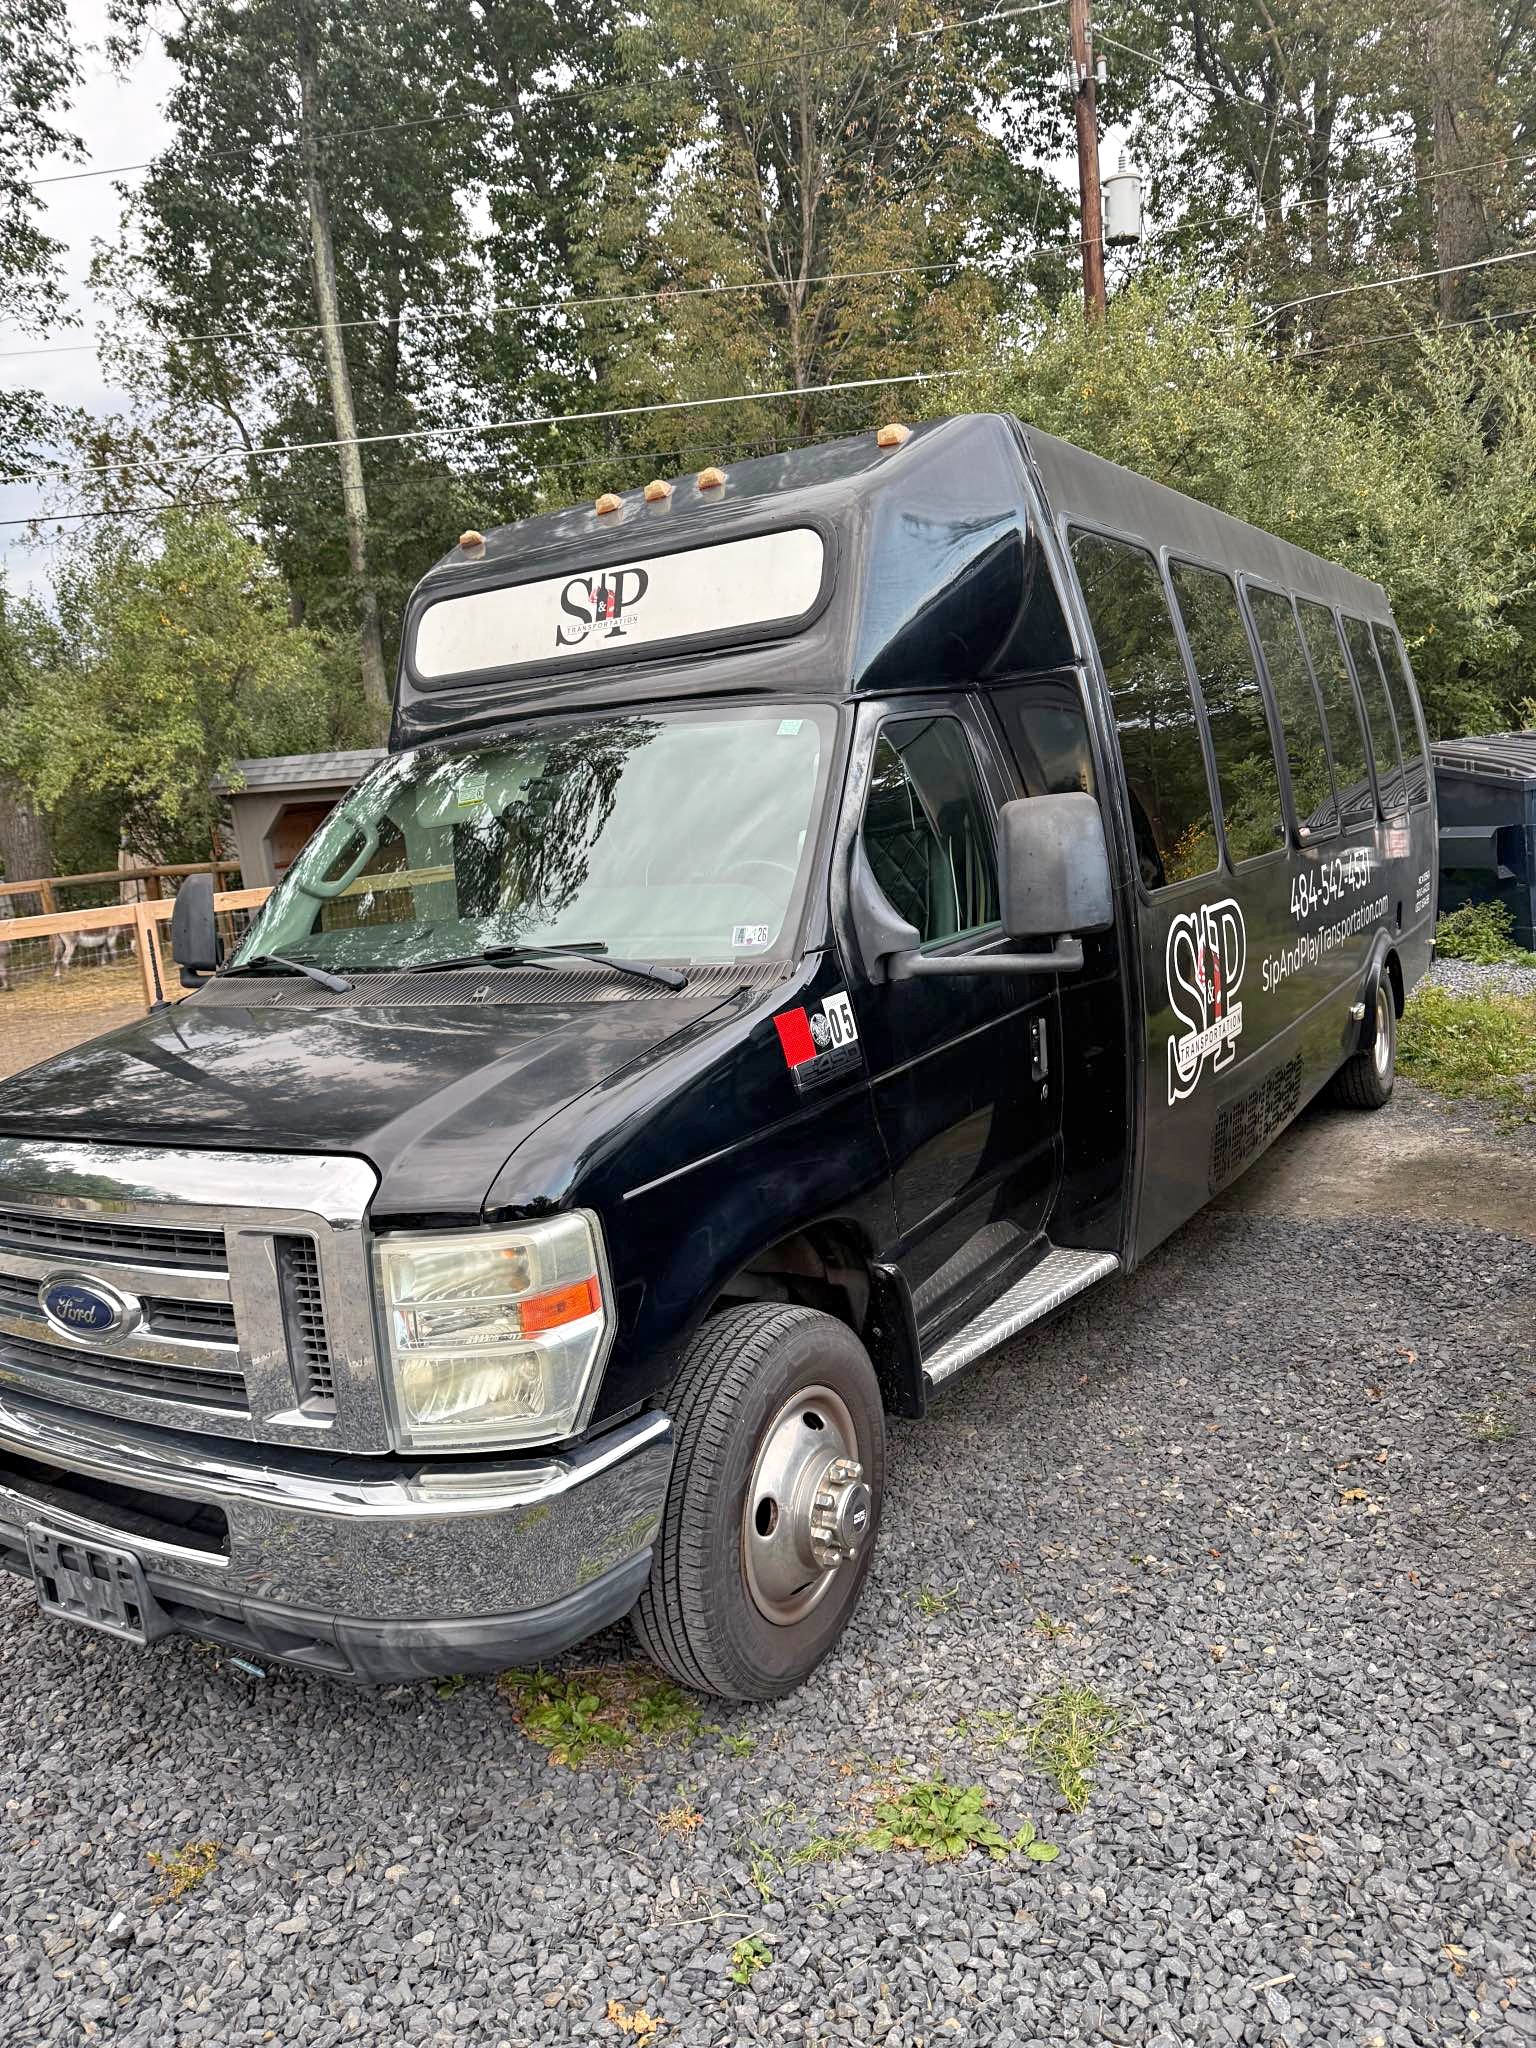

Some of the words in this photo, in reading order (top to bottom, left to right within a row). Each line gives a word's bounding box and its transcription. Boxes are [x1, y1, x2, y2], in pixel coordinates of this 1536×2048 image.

[567, 616, 638, 634] TRANSPORTATION
[1290, 848, 1371, 921] 484-542-4531
[1262, 894, 1389, 993] SipAndPlayTransportation.com
[828, 1003, 854, 1044] 05
[1180, 1013, 1241, 1062] TRANSPORTATION
[56, 1295, 97, 1324] Ford
